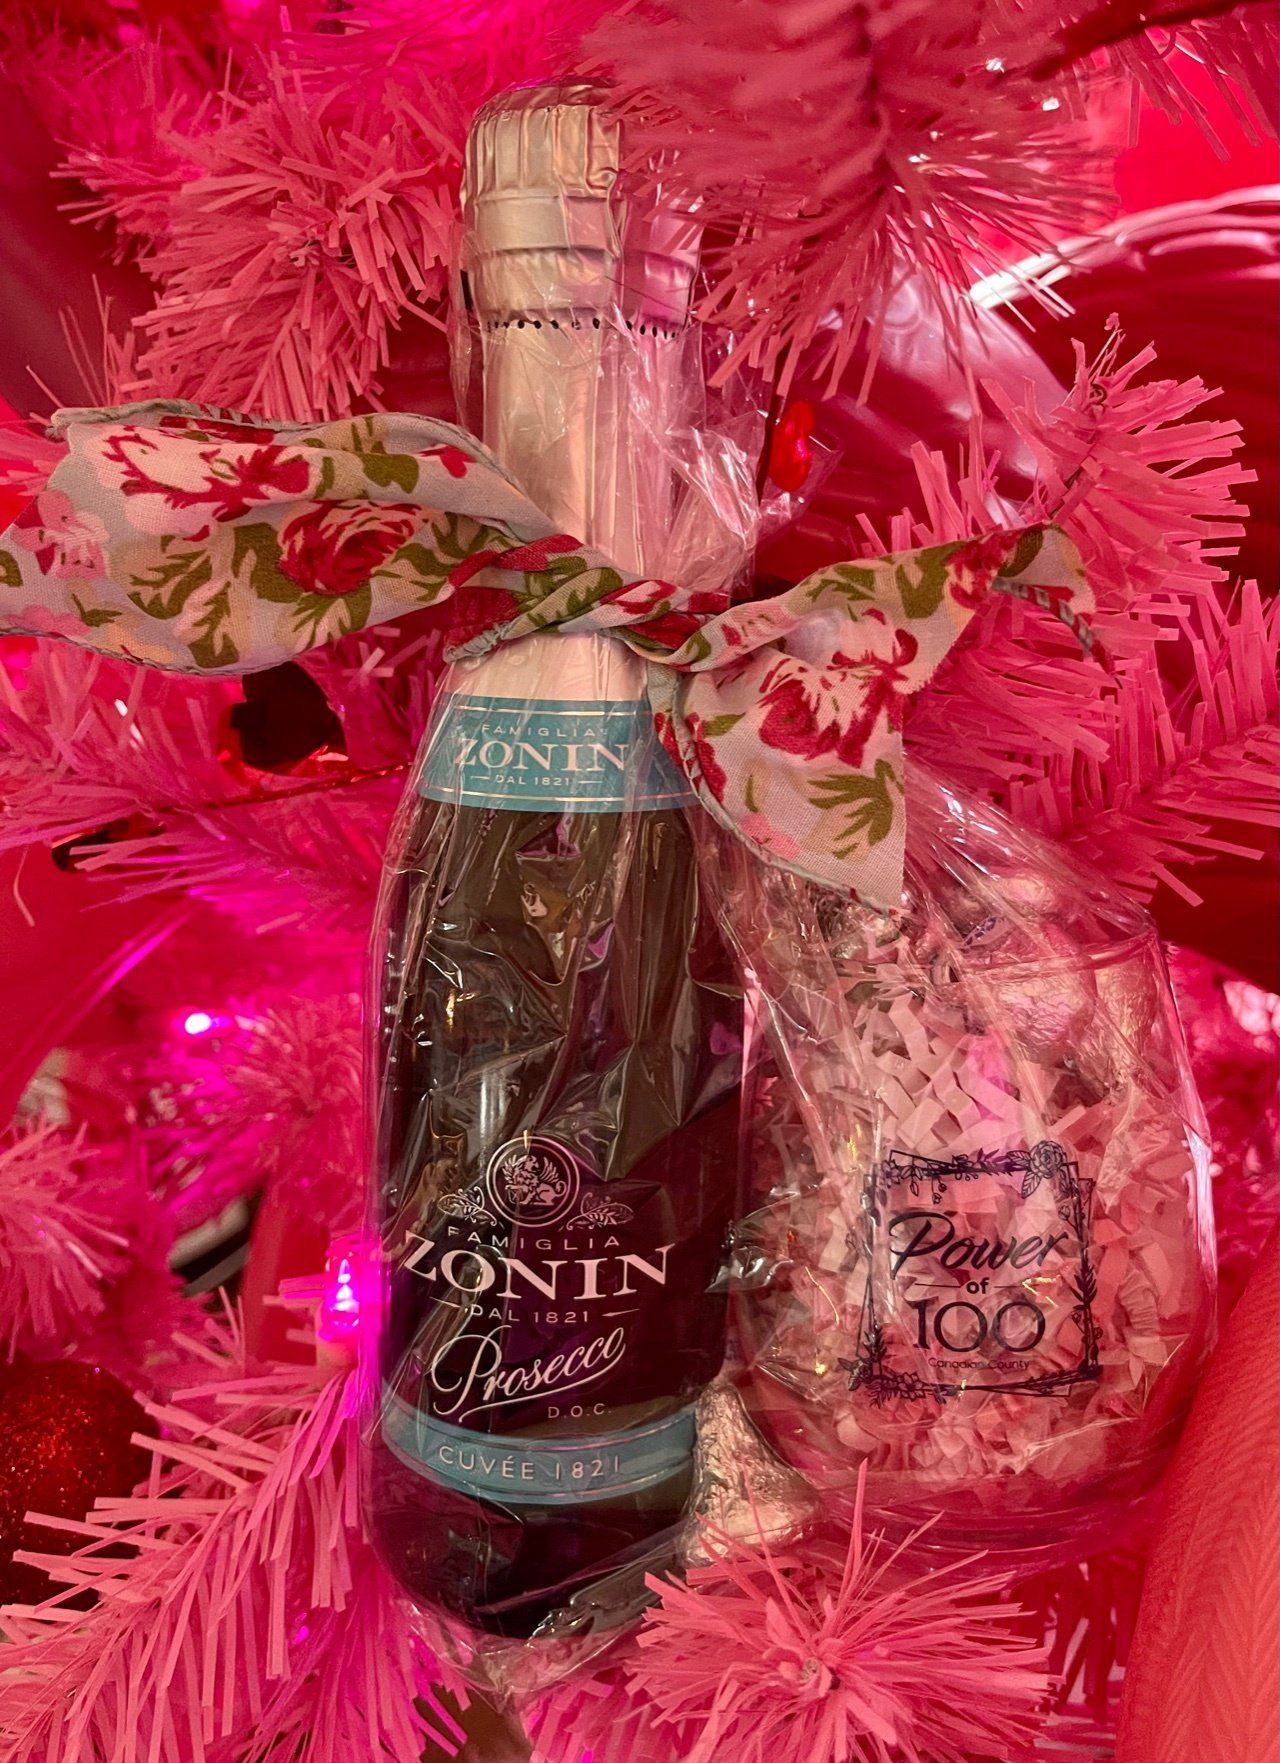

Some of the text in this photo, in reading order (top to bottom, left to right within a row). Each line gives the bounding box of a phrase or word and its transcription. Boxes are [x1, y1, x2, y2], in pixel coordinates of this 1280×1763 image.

[482, 724, 595, 737] FAMIGLIA
[454, 738, 628, 772] ZONIN
[496, 774, 570, 786] DAL 1821
[447, 1226, 620, 1250] FAMIGLIA
[888, 1211, 1069, 1281] Power
[404, 1230, 676, 1300] ZONIN
[966, 1277, 990, 1295] of
[469, 1304, 589, 1323] DAL 1821
[911, 1299, 1047, 1352] 100
[431, 1325, 626, 1416] Prosecco
[928, 1357, 1030, 1371] Canadian County
[439, 1446, 620, 1480] CUVÉE 1821
